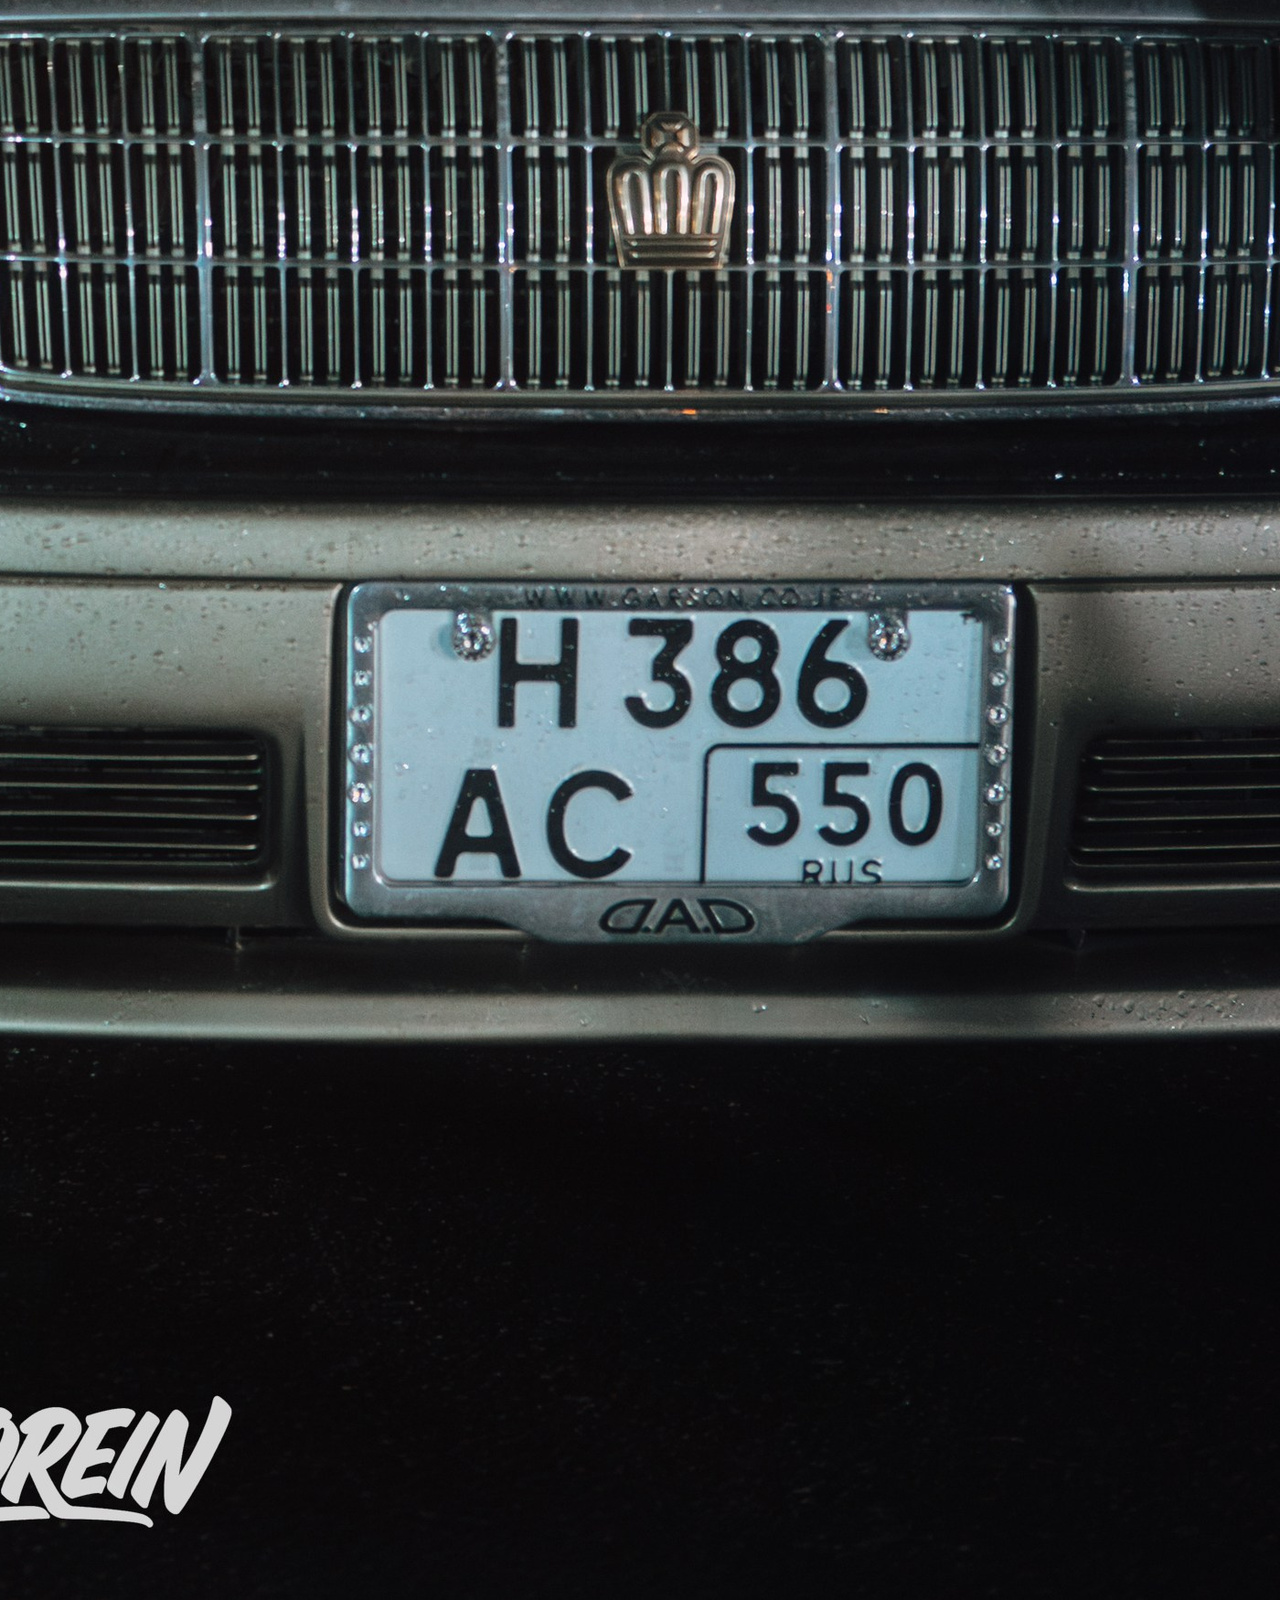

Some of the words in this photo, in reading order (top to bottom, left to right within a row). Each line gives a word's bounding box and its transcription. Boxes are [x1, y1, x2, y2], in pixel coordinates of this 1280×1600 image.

[623, 618, 868, 729] 386
[745, 761, 944, 847] 550
[802, 858, 882, 885] RUS
